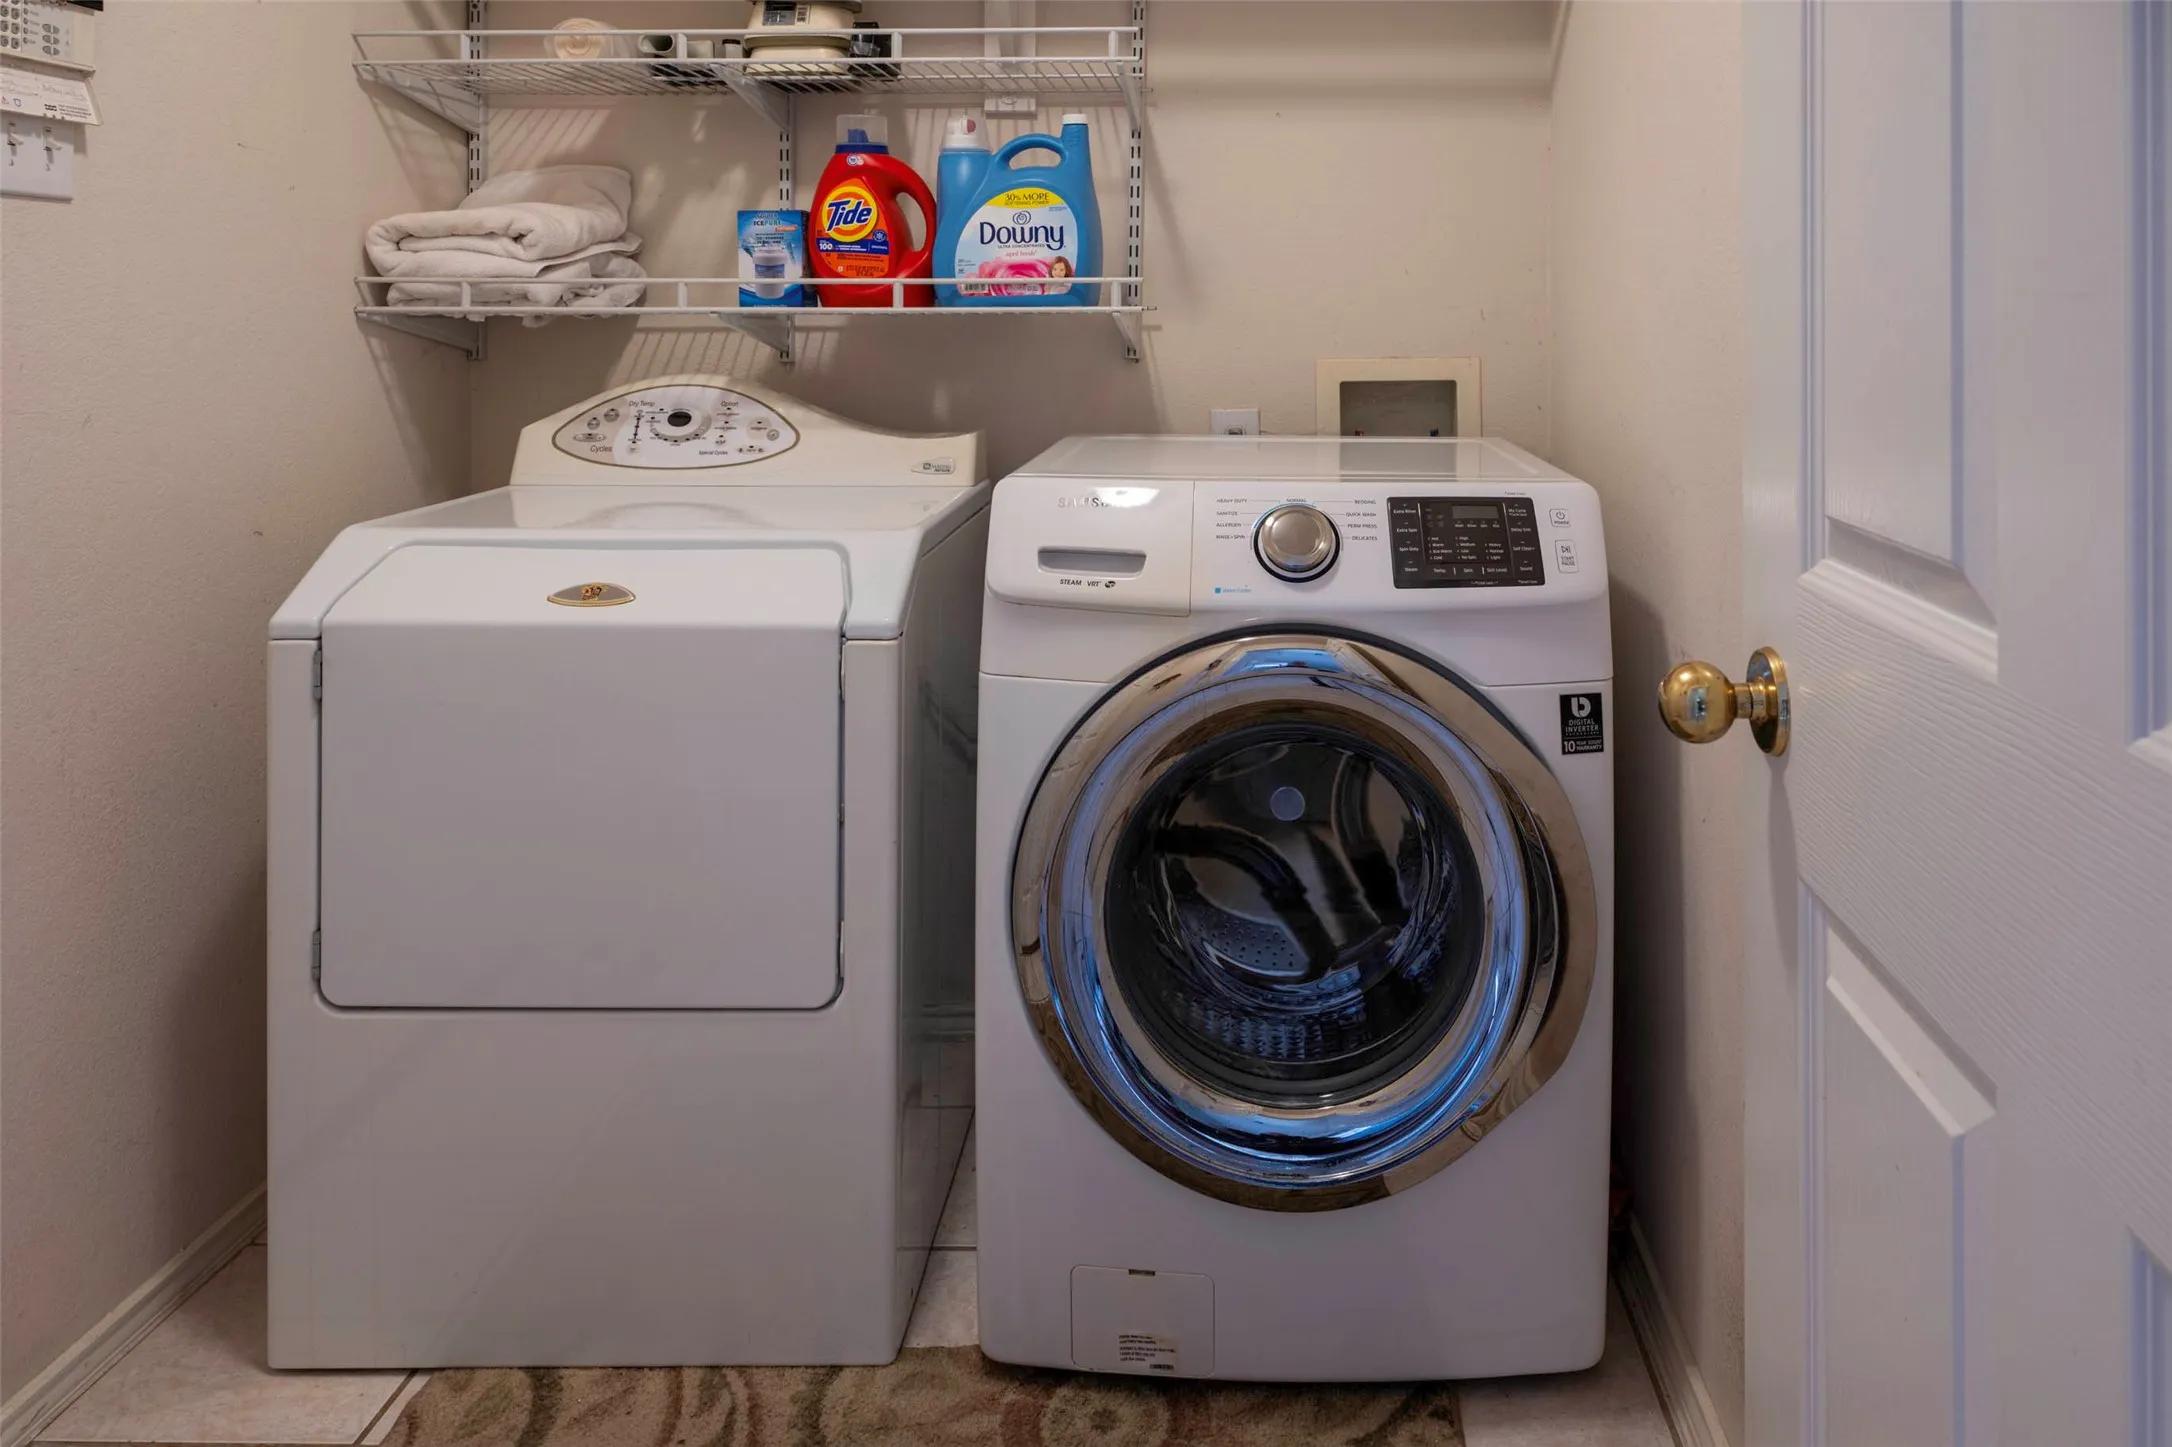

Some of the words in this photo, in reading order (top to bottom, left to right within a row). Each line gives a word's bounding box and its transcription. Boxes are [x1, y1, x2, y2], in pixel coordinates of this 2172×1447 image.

[1005, 193, 1021, 201] 30%
[1023, 192, 1050, 200] MORE
[826, 199, 873, 232] Tide
[980, 221, 1064, 251] Downy
[590, 444, 613, 453] Cycles
[1060, 578, 1082, 586] STEAM
[1564, 741, 1575, 752] 10
